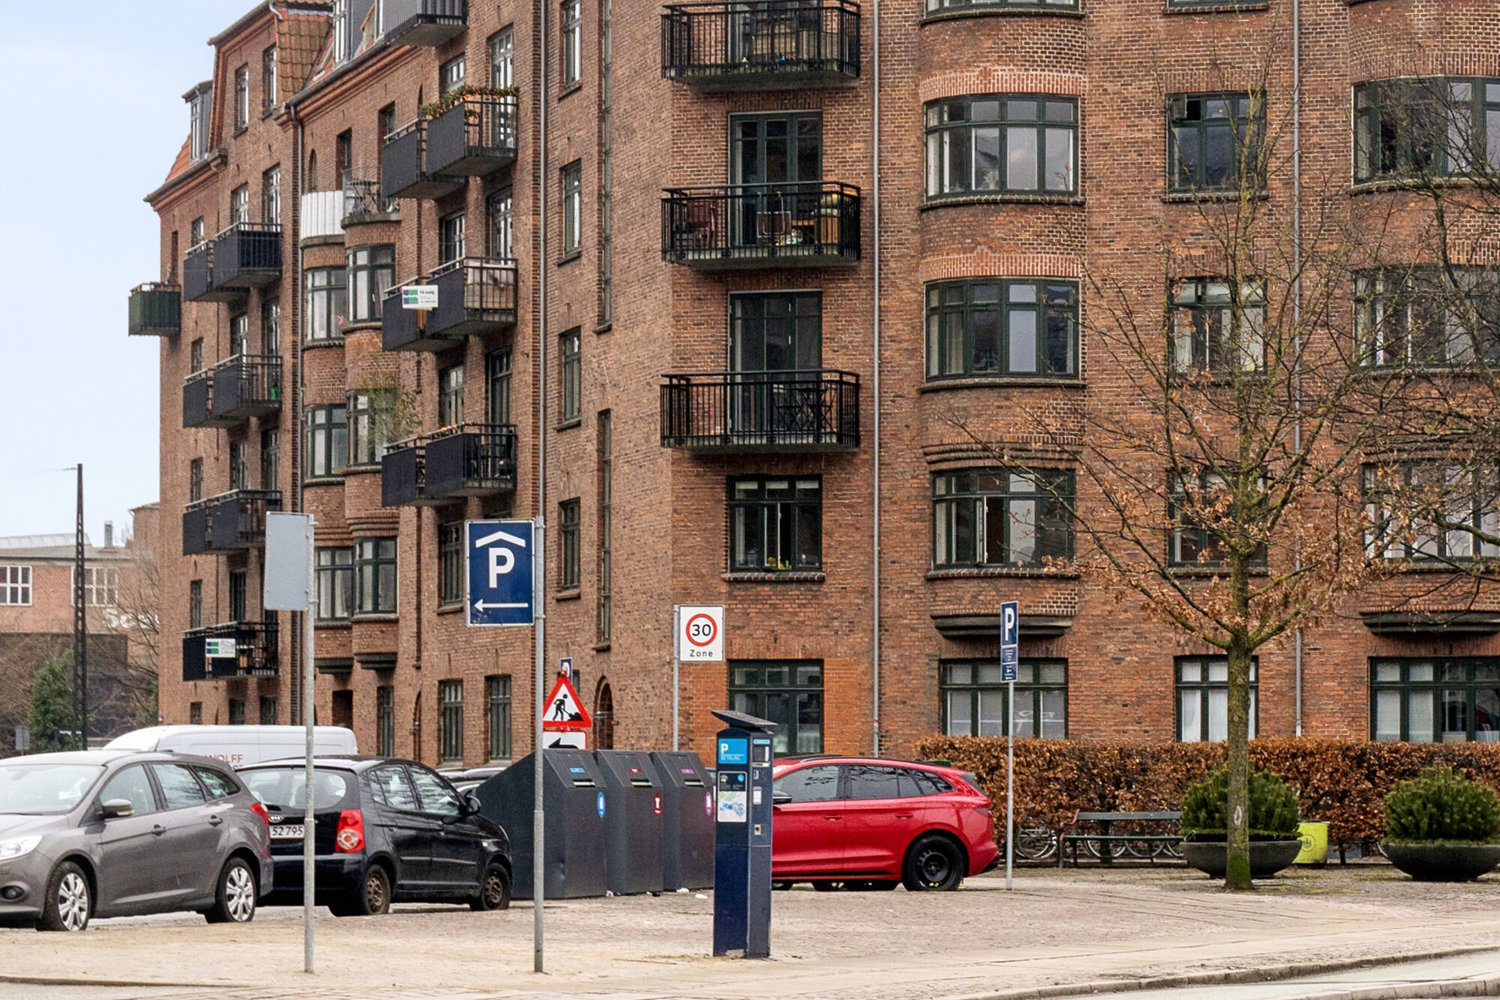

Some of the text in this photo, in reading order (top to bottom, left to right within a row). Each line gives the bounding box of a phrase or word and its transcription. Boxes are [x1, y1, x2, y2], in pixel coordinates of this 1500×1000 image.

[489, 547, 515, 589] P
[692, 623, 712, 637] 30
[1004, 607, 1015, 641] P
[689, 649, 714, 658] Zone
[720, 743, 729, 754] P
[272, 826, 303, 836] 52 795
